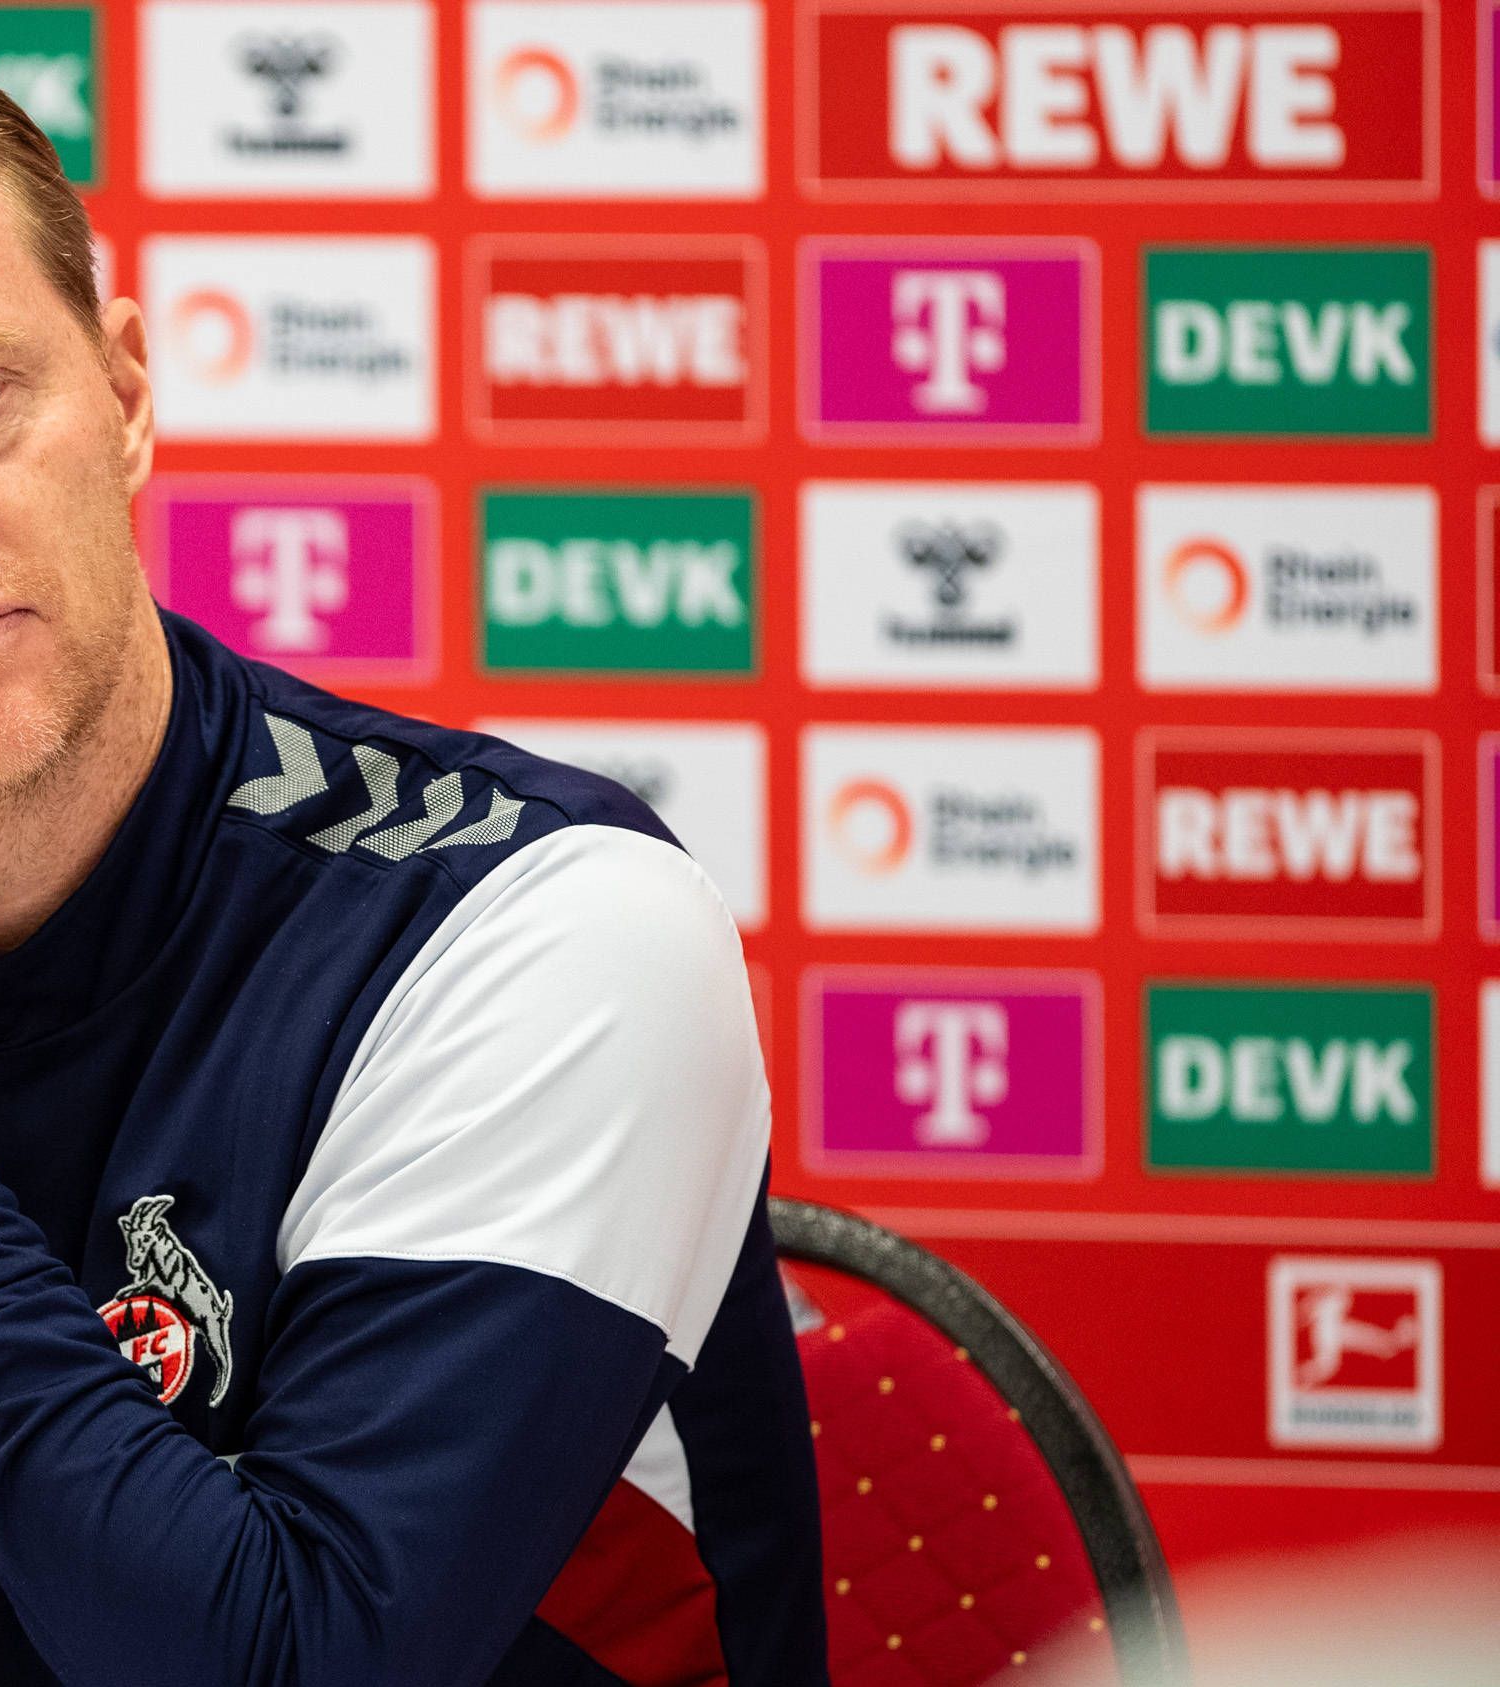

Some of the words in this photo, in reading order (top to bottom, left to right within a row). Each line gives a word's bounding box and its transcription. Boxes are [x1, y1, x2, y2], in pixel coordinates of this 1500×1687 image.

[890, 25, 1343, 168] REWE
[484, 295, 745, 384] REWE
[893, 271, 1005, 413] T
[1156, 301, 1414, 384] DEVK
[490, 536, 744, 629] DEVK
[1156, 788, 1420, 880] REWE
[895, 1001, 1007, 1145] T
[1158, 1036, 1415, 1122] DEVK
[132, 1330, 169, 1363] FC
